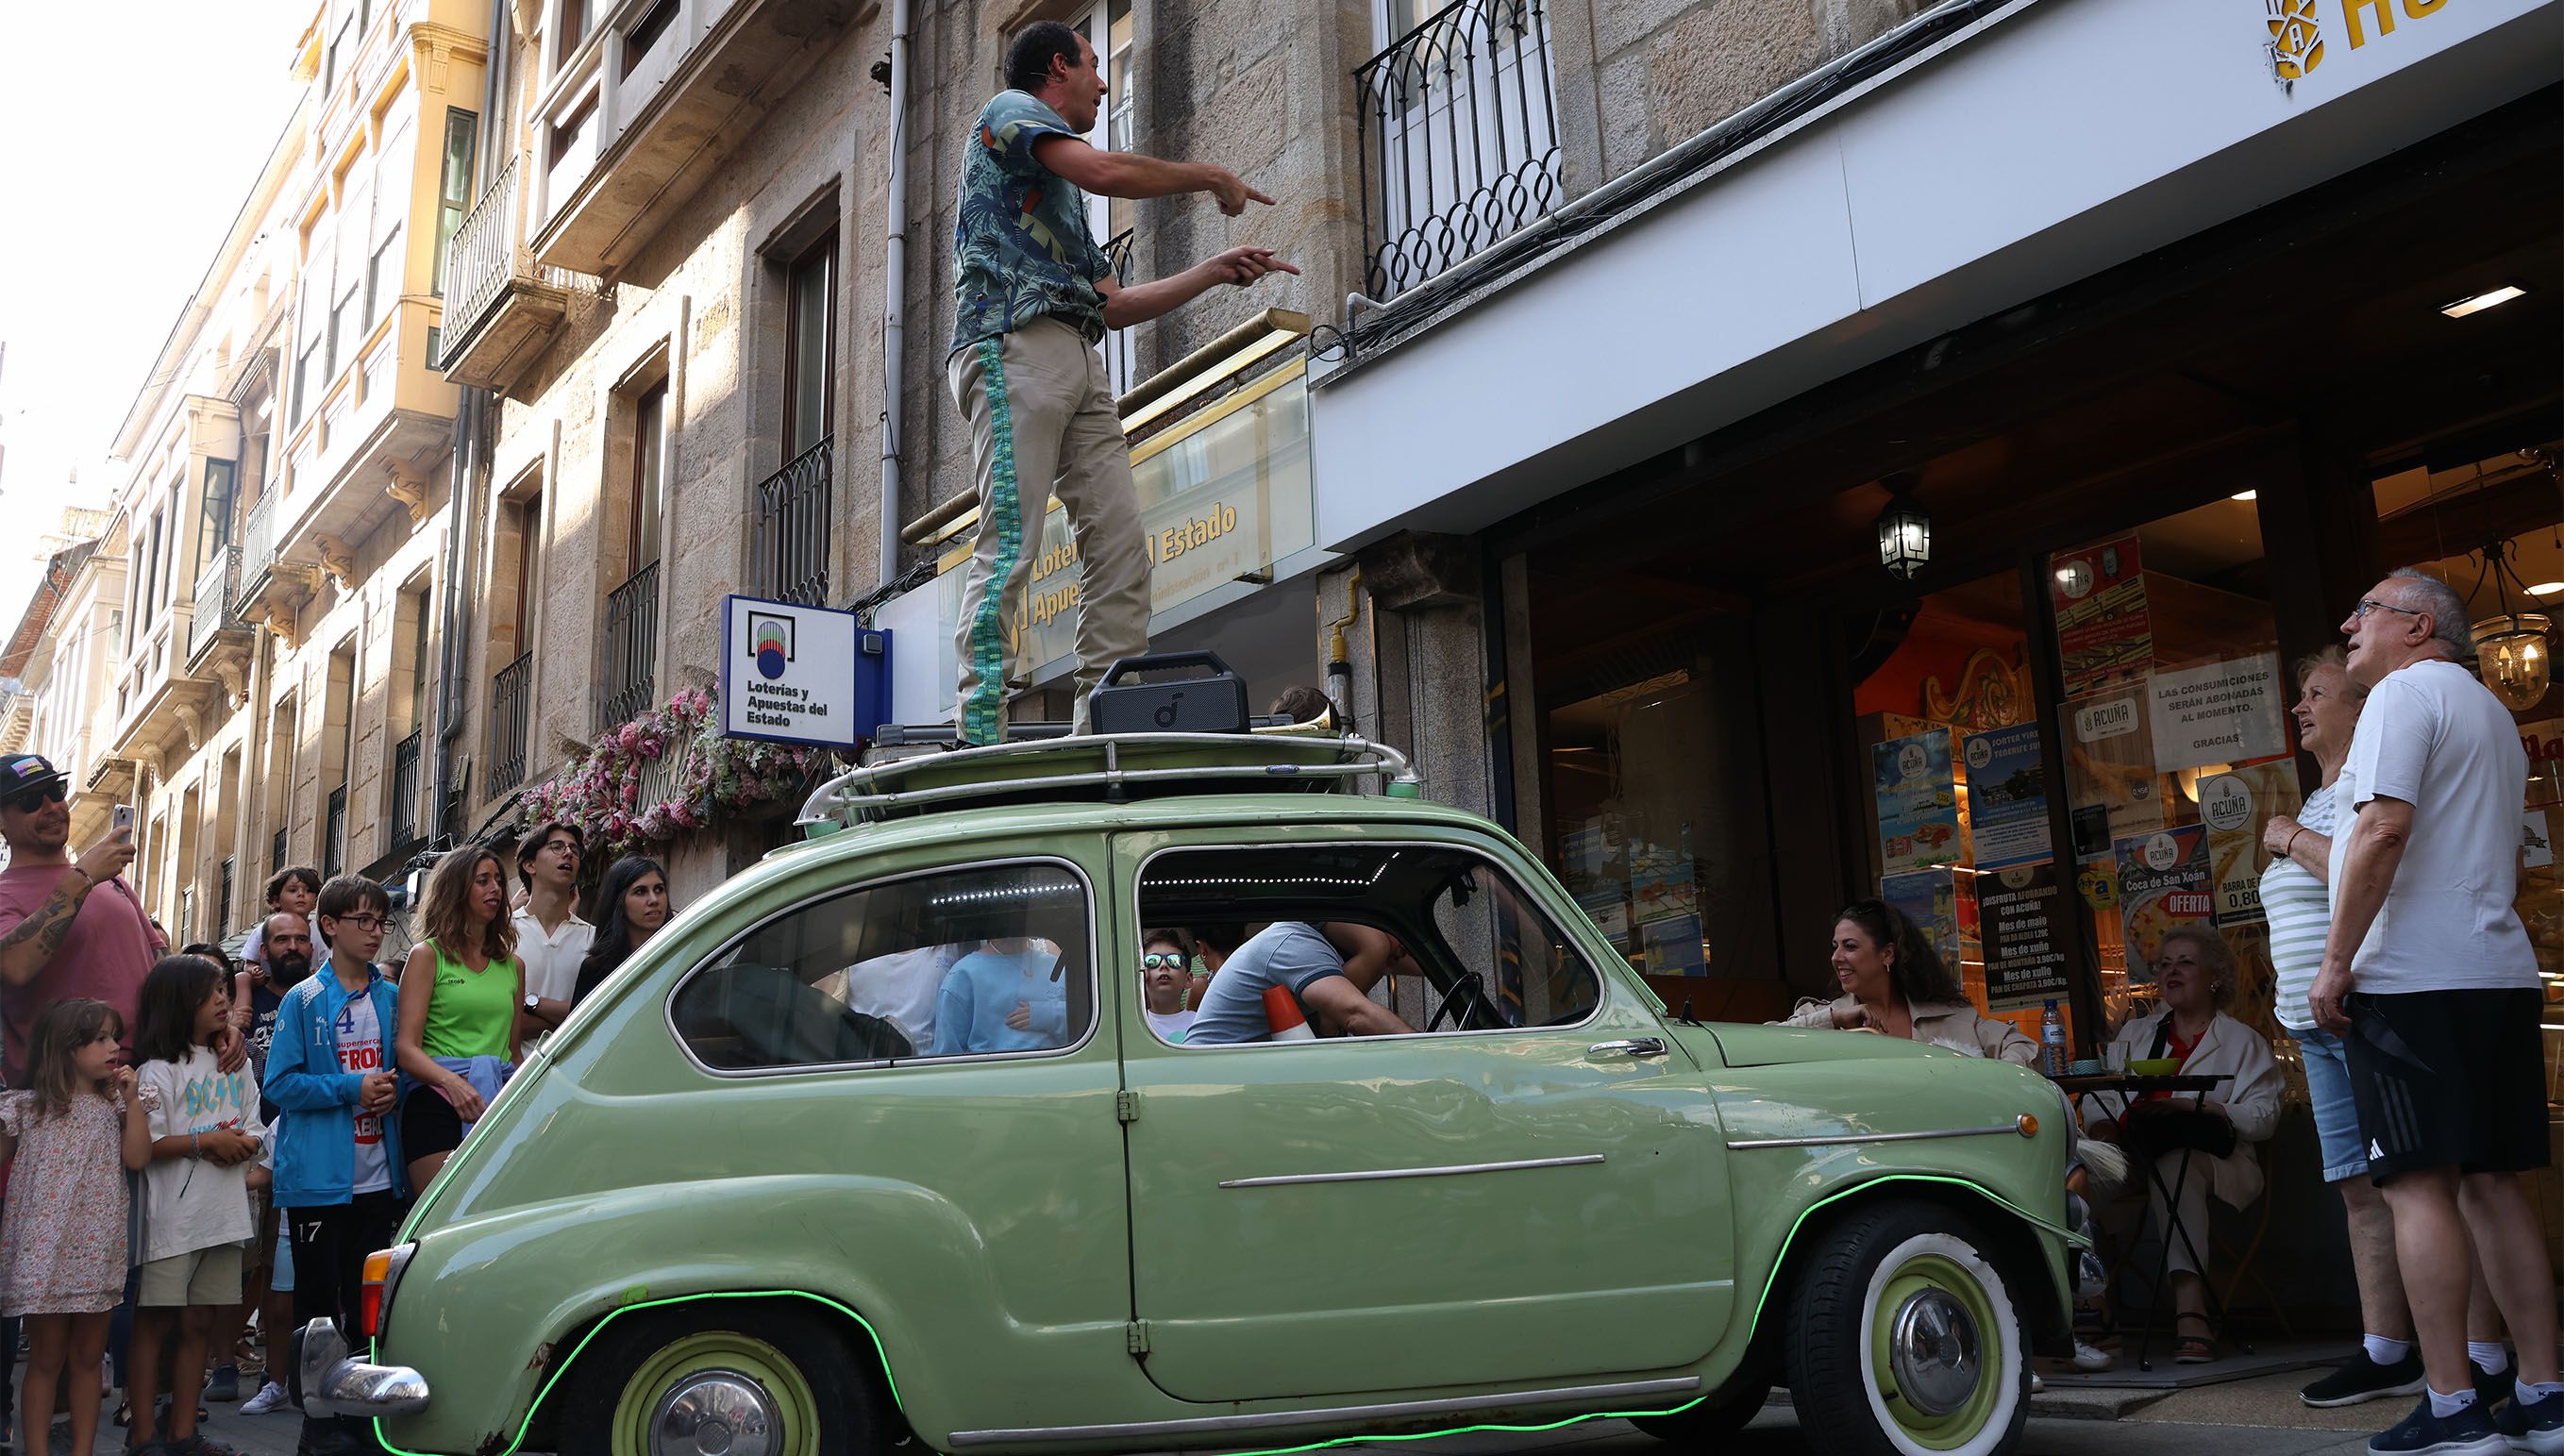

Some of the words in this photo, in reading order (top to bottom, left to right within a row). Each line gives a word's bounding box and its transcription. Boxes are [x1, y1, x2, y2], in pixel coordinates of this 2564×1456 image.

[1031, 541, 1078, 583] Loter
[1162, 502, 1236, 563] Estado
[1033, 582, 1080, 628] Apue
[747, 680, 798, 697] Loterías
[801, 689, 809, 701] y
[2158, 688, 2178, 699] LAS
[2181, 671, 2270, 695] CONSUMICIONES
[747, 695, 806, 713] Apuestas
[809, 703, 828, 716] del
[2169, 697, 2203, 711] SERÁN
[2205, 687, 2264, 705] ABONADAS
[746, 711, 791, 727] Estado
[2093, 703, 2129, 728] ACUÑA
[2181, 714, 2194, 724] AL
[2197, 704, 2254, 720] MOMENTO.
[2021, 729, 2039, 741] VIAX
[1902, 758, 1923, 771] ACUÑA
[2211, 795, 2246, 817] ACUÑA
[2150, 846, 2174, 862] ACUÑA
[2126, 879, 2149, 892] Coca
[2150, 877, 2161, 888] de
[2163, 874, 2181, 886] San
[2182, 868, 2205, 882] Xoán
[2222, 879, 2246, 893] BARRA
[2247, 878, 2256, 889] DE
[2001, 905, 2016, 916] CON
[2016, 900, 2041, 913] ACUÑA!
[2170, 894, 2210, 912] OFERTA
[1999, 921, 2015, 932] Mes
[2016, 919, 2027, 929] de
[2002, 946, 2017, 957] Mes
[2019, 945, 2029, 955] de
[2030, 942, 2050, 952] xuño
[2004, 971, 2020, 981] Mes
[2020, 969, 2031, 979] de
[2032, 966, 2052, 978] xullo
[337, 1038, 382, 1048] supermerca
[297, 1220, 323, 1244] 17
